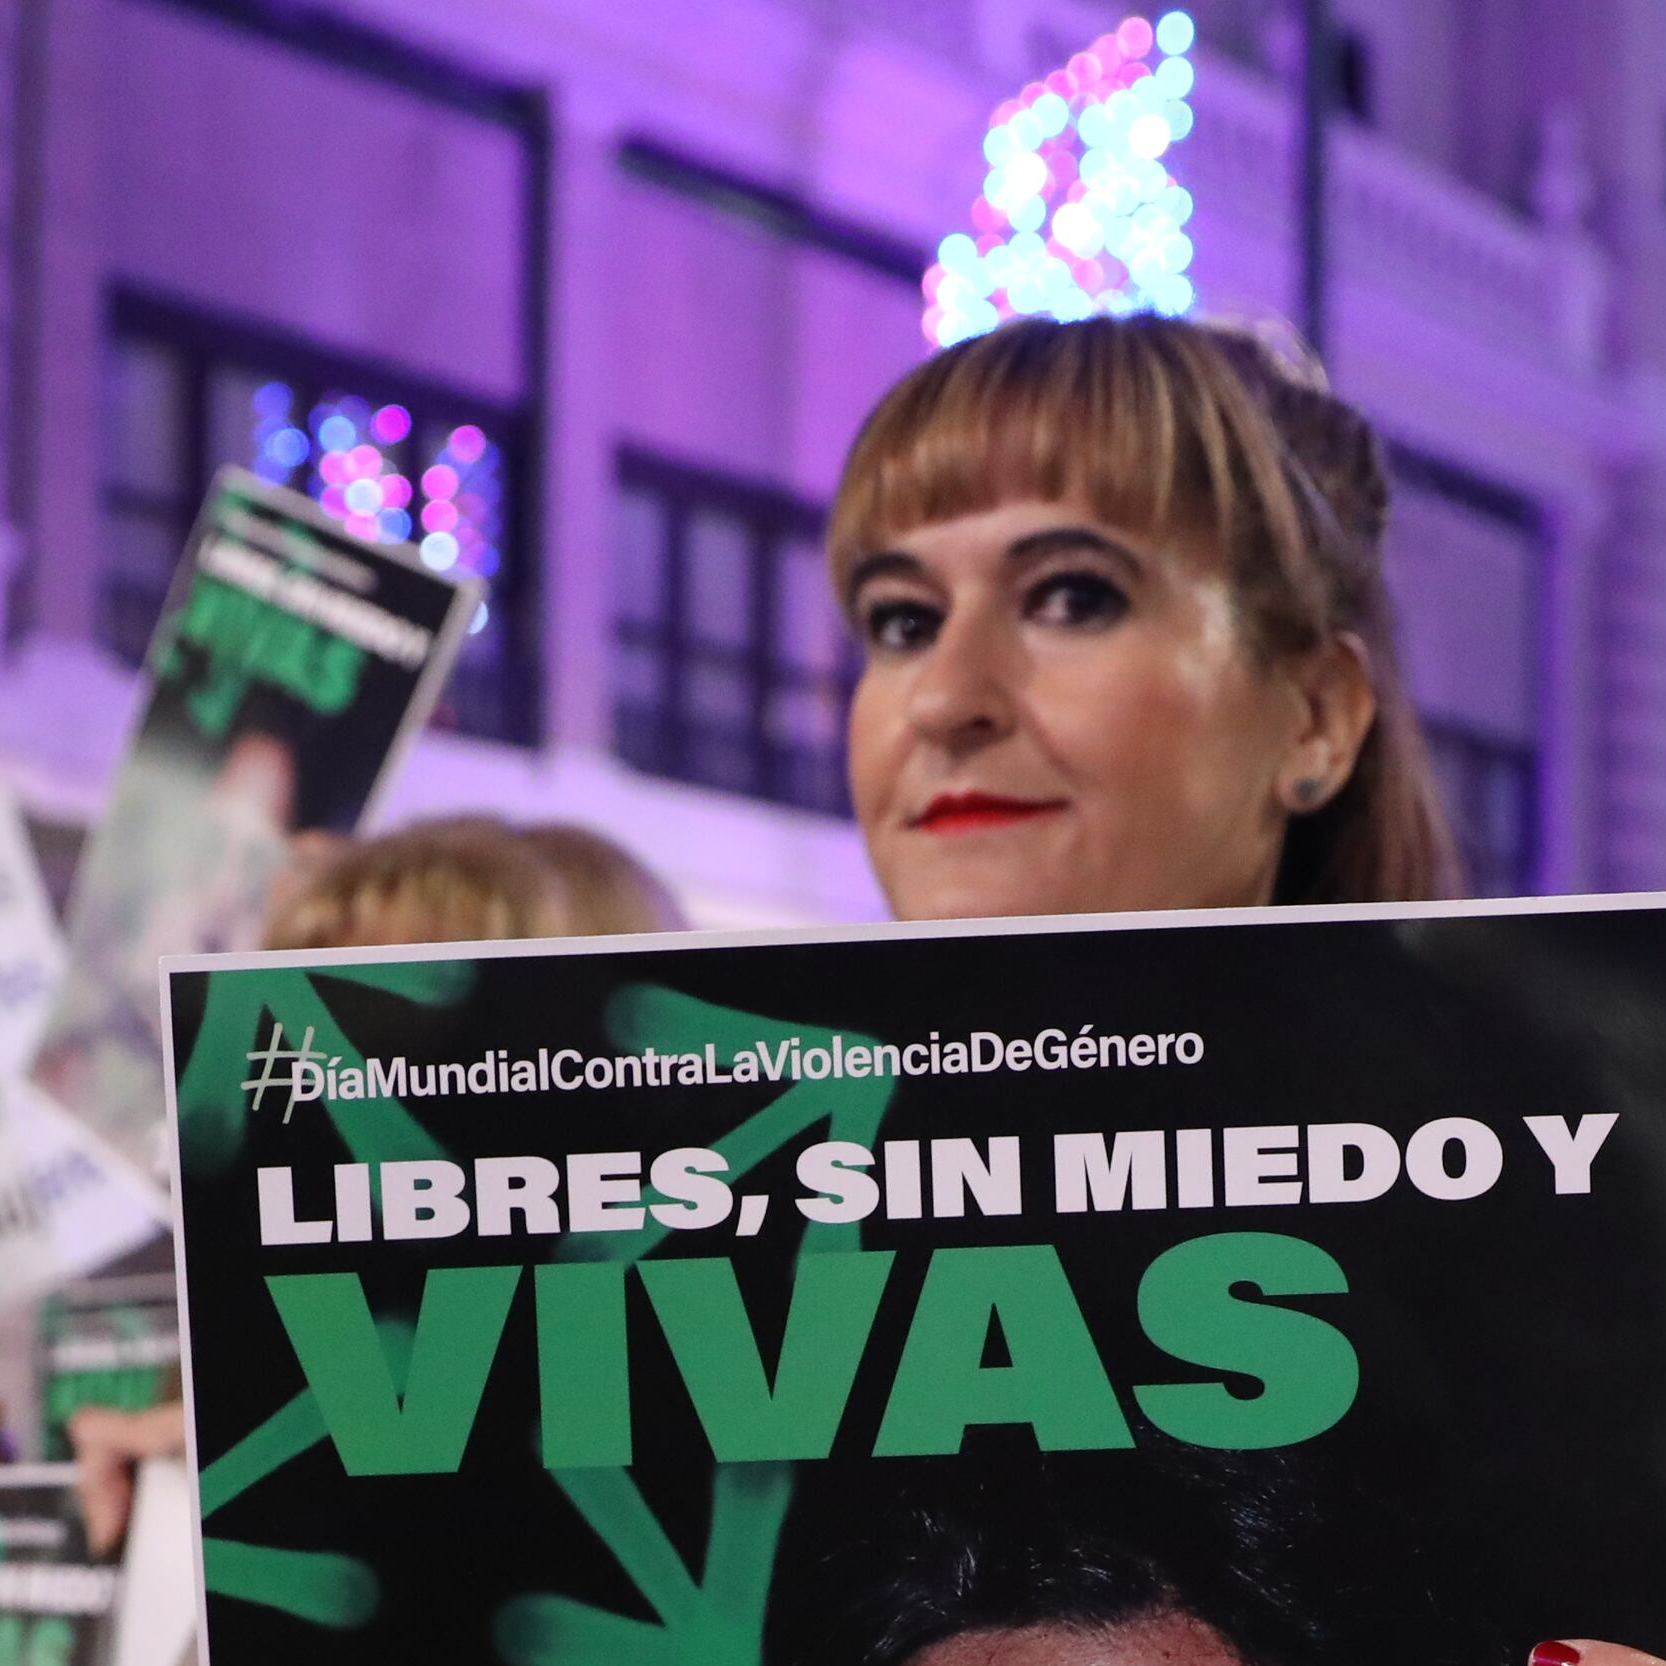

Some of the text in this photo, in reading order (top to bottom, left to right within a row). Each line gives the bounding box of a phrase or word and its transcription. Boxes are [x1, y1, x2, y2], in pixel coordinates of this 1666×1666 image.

[240, 1022, 1205, 1124] #DíaMundialContraLaViolenciaDeGénero
[257, 1113, 1621, 1246] LIBRES, SIN MIEDO Y
[264, 1231, 1360, 1477] VIVAS
